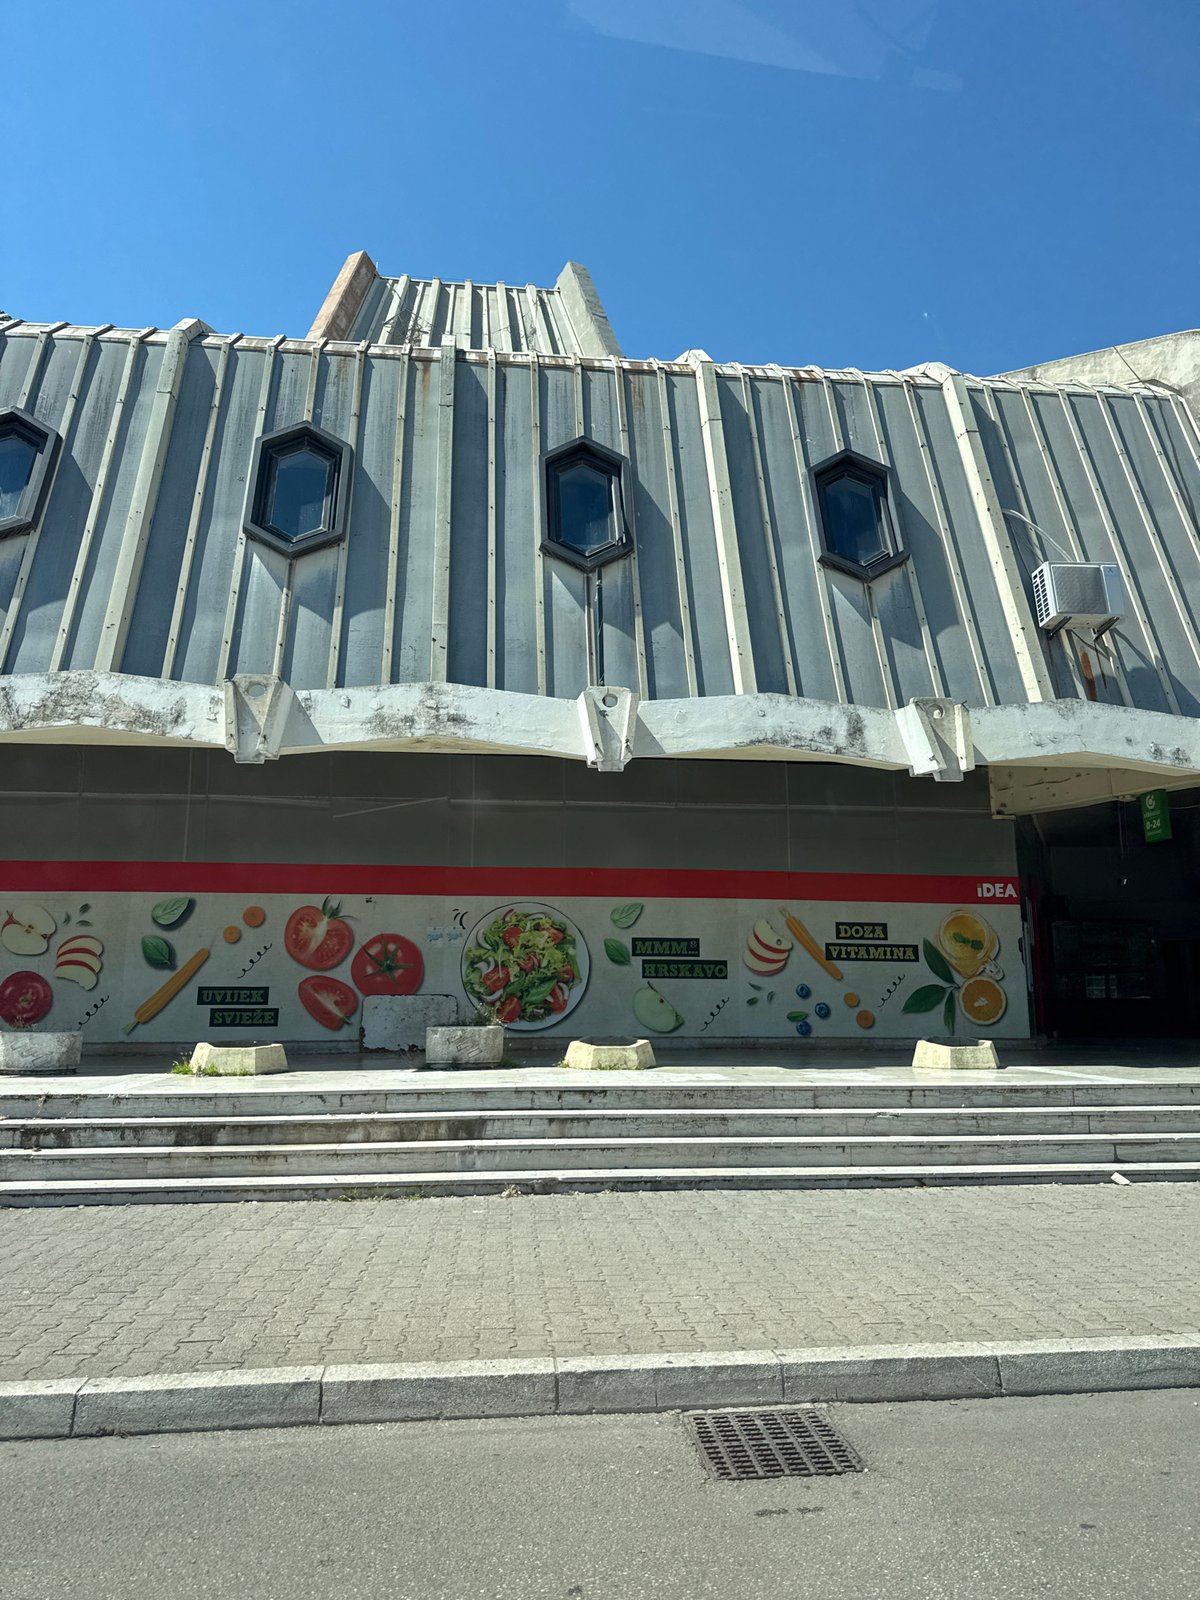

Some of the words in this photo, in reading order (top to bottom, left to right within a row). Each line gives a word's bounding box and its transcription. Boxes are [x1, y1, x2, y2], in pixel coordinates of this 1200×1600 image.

[839, 925, 885, 938] DOZA
[829, 946, 915, 959] VITAMINA
[643, 964, 727, 977] HRSKAVO
[202, 990, 264, 1002] UVIJEK
[213, 1009, 274, 1024] SVJEŽE
